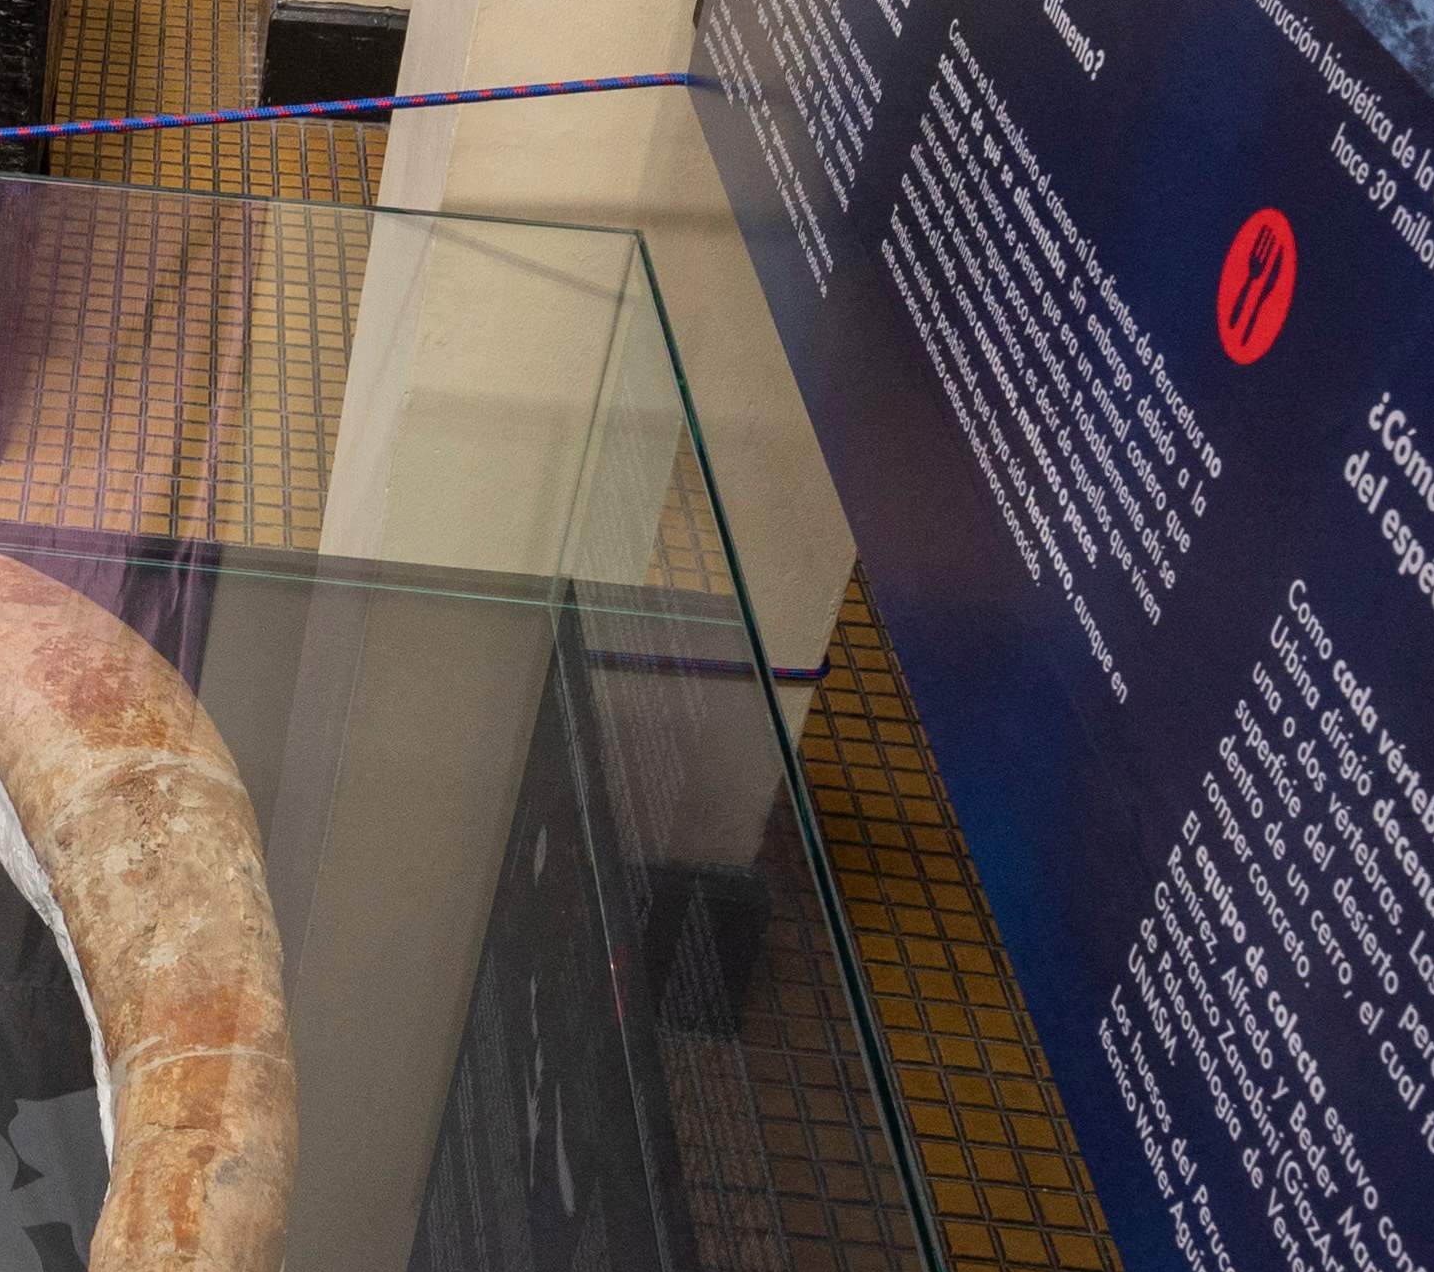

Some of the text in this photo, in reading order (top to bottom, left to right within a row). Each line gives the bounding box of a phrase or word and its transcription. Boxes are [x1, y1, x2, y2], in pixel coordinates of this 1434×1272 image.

[1317, 40, 1394, 144] hipotética
[1389, 126, 1416, 170] de
[1328, 120, 1370, 186] hace
[1367, 167, 1398, 211] 39
[948, 17, 1222, 479] Como no se ha descubierto el cráneo ni los dientes de Perucetus no
[1342, 448, 1390, 515] del
[1268, 613, 1321, 711] Urbina
[1318, 706, 1374, 797] dirigió
[1286, 577, 1334, 661] Como
[1331, 657, 1379, 735] cada
[1233, 697, 1302, 819] superficie
[1301, 821, 1337, 873] del
[1331, 875, 1400, 996] desierto
[1250, 659, 1283, 715] una
[1281, 714, 1297, 740] o
[1295, 737, 1328, 794] dos
[1327, 790, 1404, 935] vértebras.
[1180, 808, 1202, 847] El
[1193, 843, 1247, 945] equipo
[1243, 943, 1269, 990] de
[1265, 988, 1327, 1105] colecta
[1322, 1105, 1379, 1211] estuvo
[1217, 733, 1265, 820] dentro
[1262, 819, 1287, 862] de
[1285, 861, 1311, 907] un
[1308, 907, 1353, 1000] cerro,
[1357, 999, 1385, 1036] el
[1378, 1038, 1426, 1112] cual
